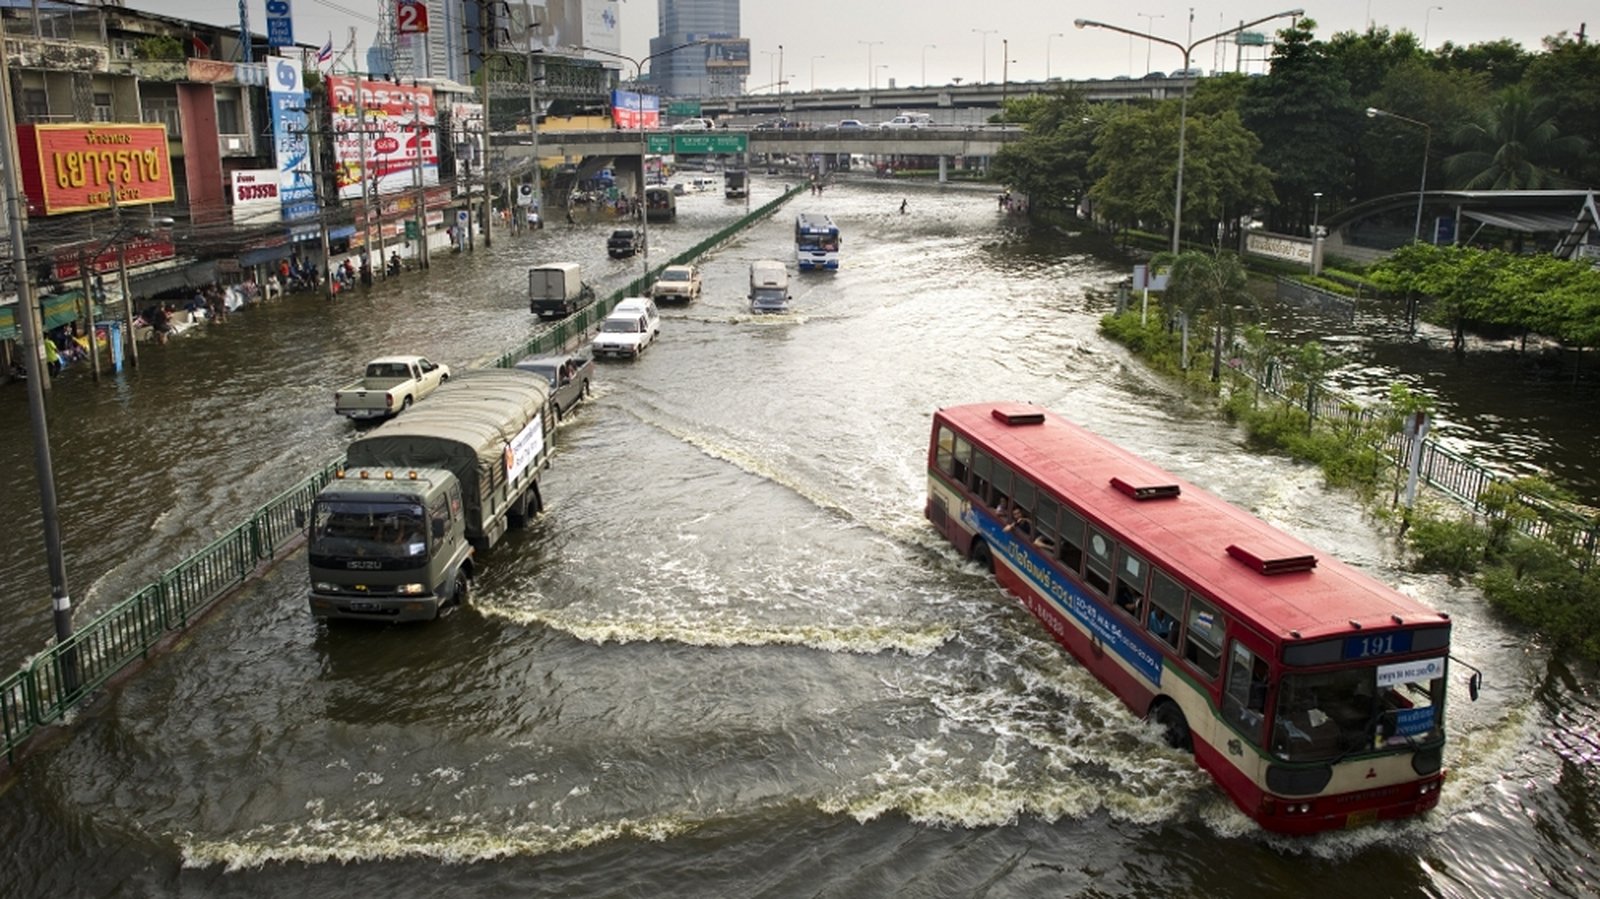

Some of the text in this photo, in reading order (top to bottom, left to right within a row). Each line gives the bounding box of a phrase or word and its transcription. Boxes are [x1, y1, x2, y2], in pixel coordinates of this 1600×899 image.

[54, 147, 160, 189] เยาวราช
[347, 561, 381, 569] ISUZU
[1051, 581, 1073, 609] 2011
[1360, 635, 1394, 657] 191
